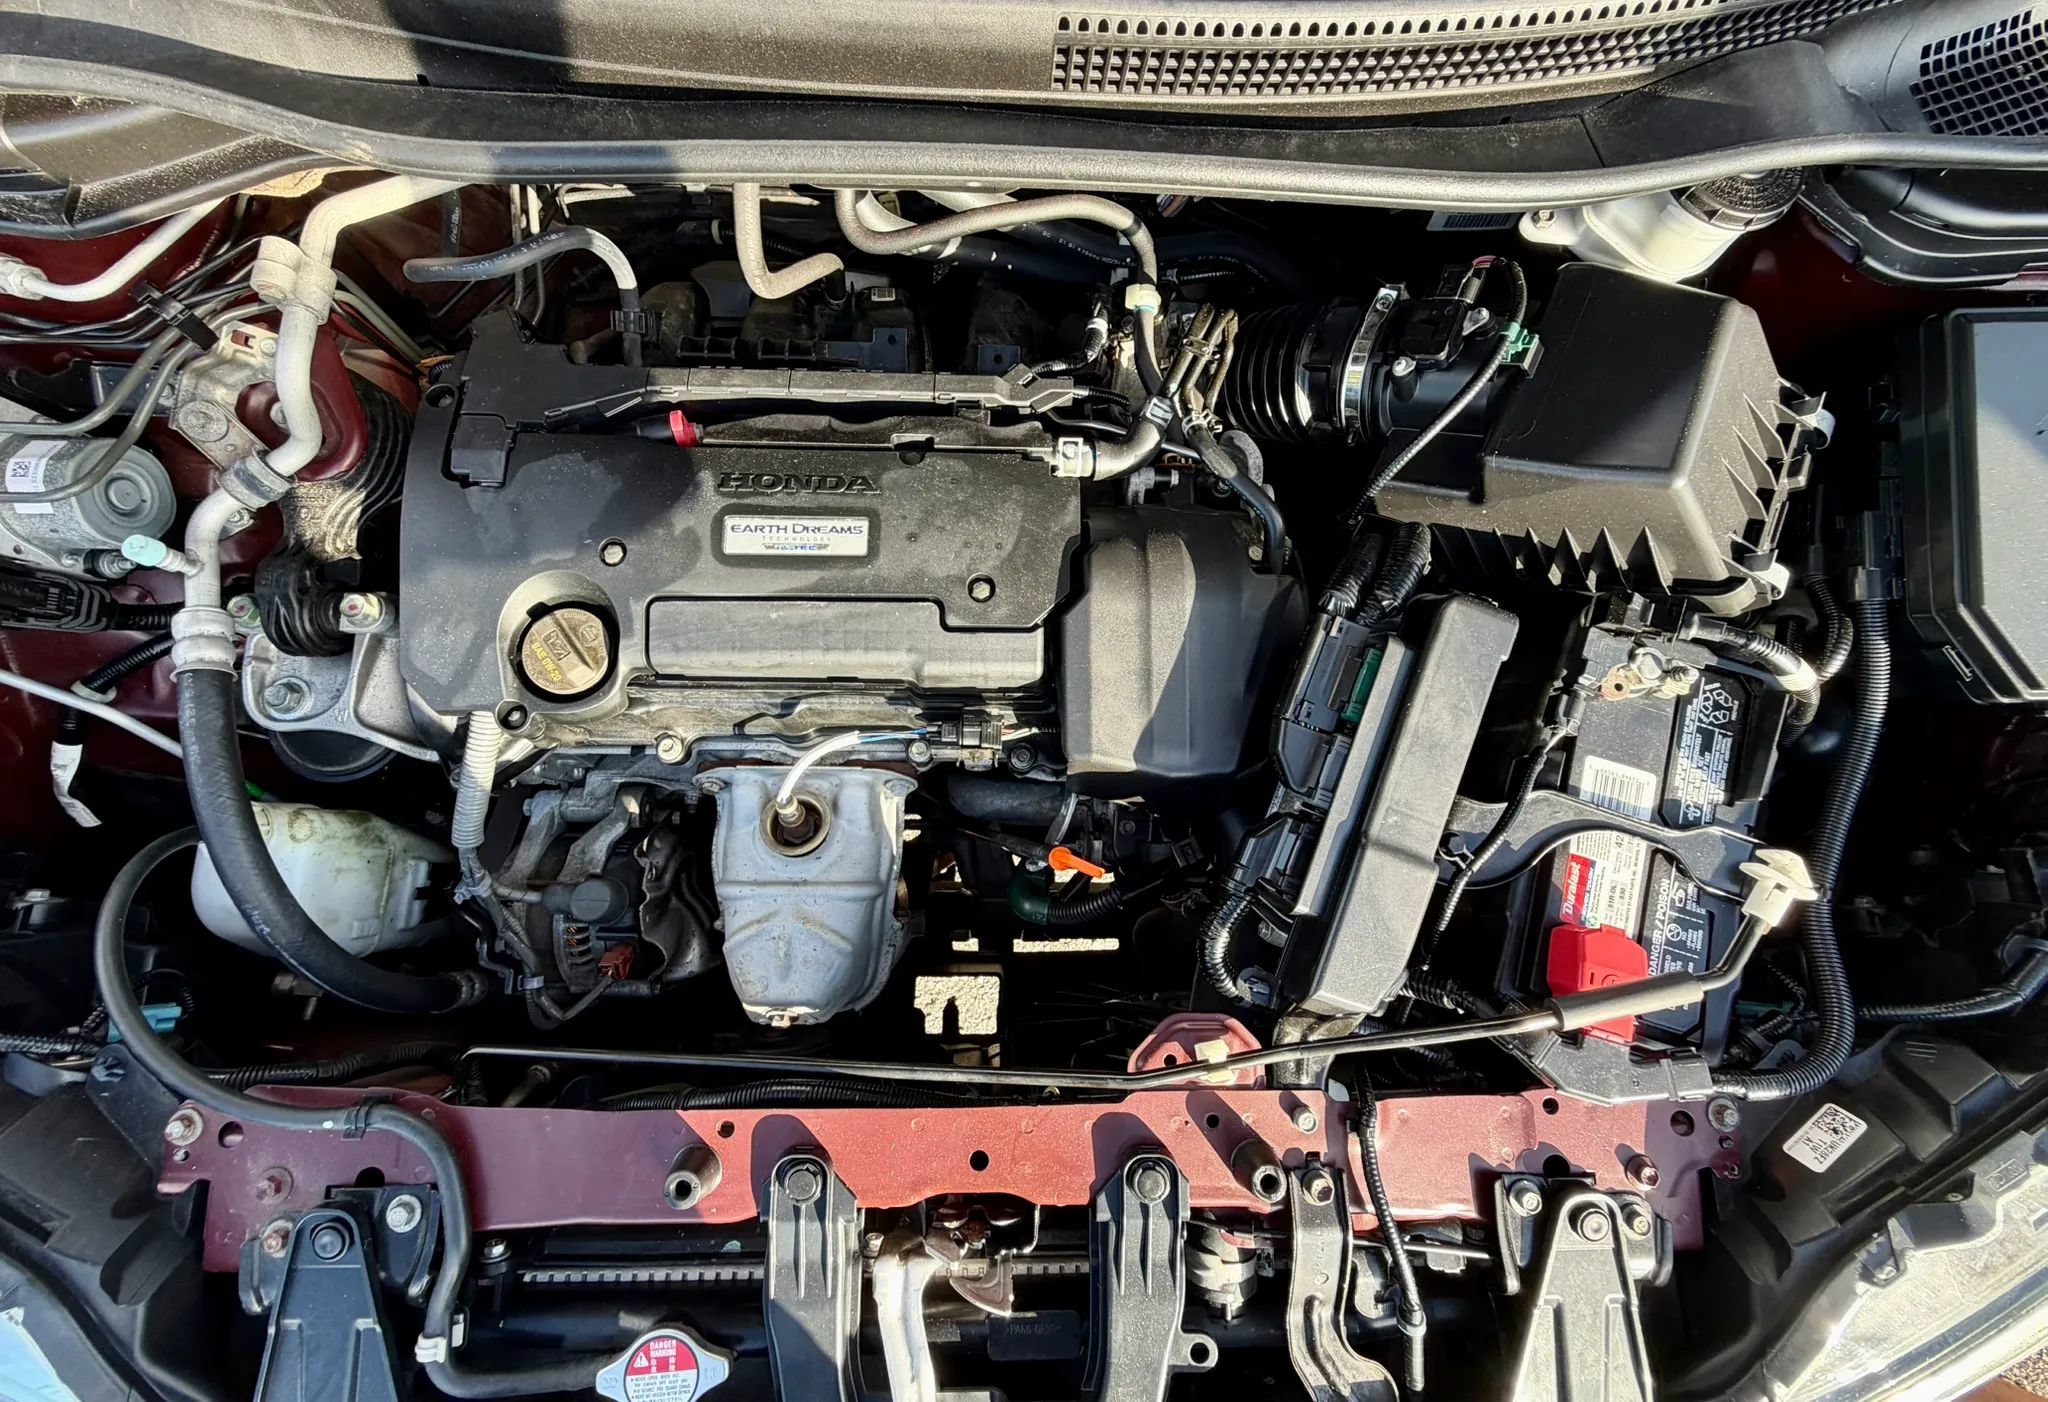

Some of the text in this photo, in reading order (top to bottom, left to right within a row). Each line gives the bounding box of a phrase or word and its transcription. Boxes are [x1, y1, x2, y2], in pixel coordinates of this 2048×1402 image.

[717, 471, 881, 494] HONDA
[730, 523, 788, 534] EARTH
[530, 641, 547, 660] SAE
[541, 657, 563, 683] 0W-20
[1614, 835, 1624, 849] 42
[1562, 861, 1582, 916] Duralast
[1585, 867, 1594, 891] TOUGH
[1647, 929, 1663, 976] DANGER
[1656, 878, 1671, 919] POISON
[1680, 931, 1688, 941] NO
[650, 1339, 677, 1351] DANGER
